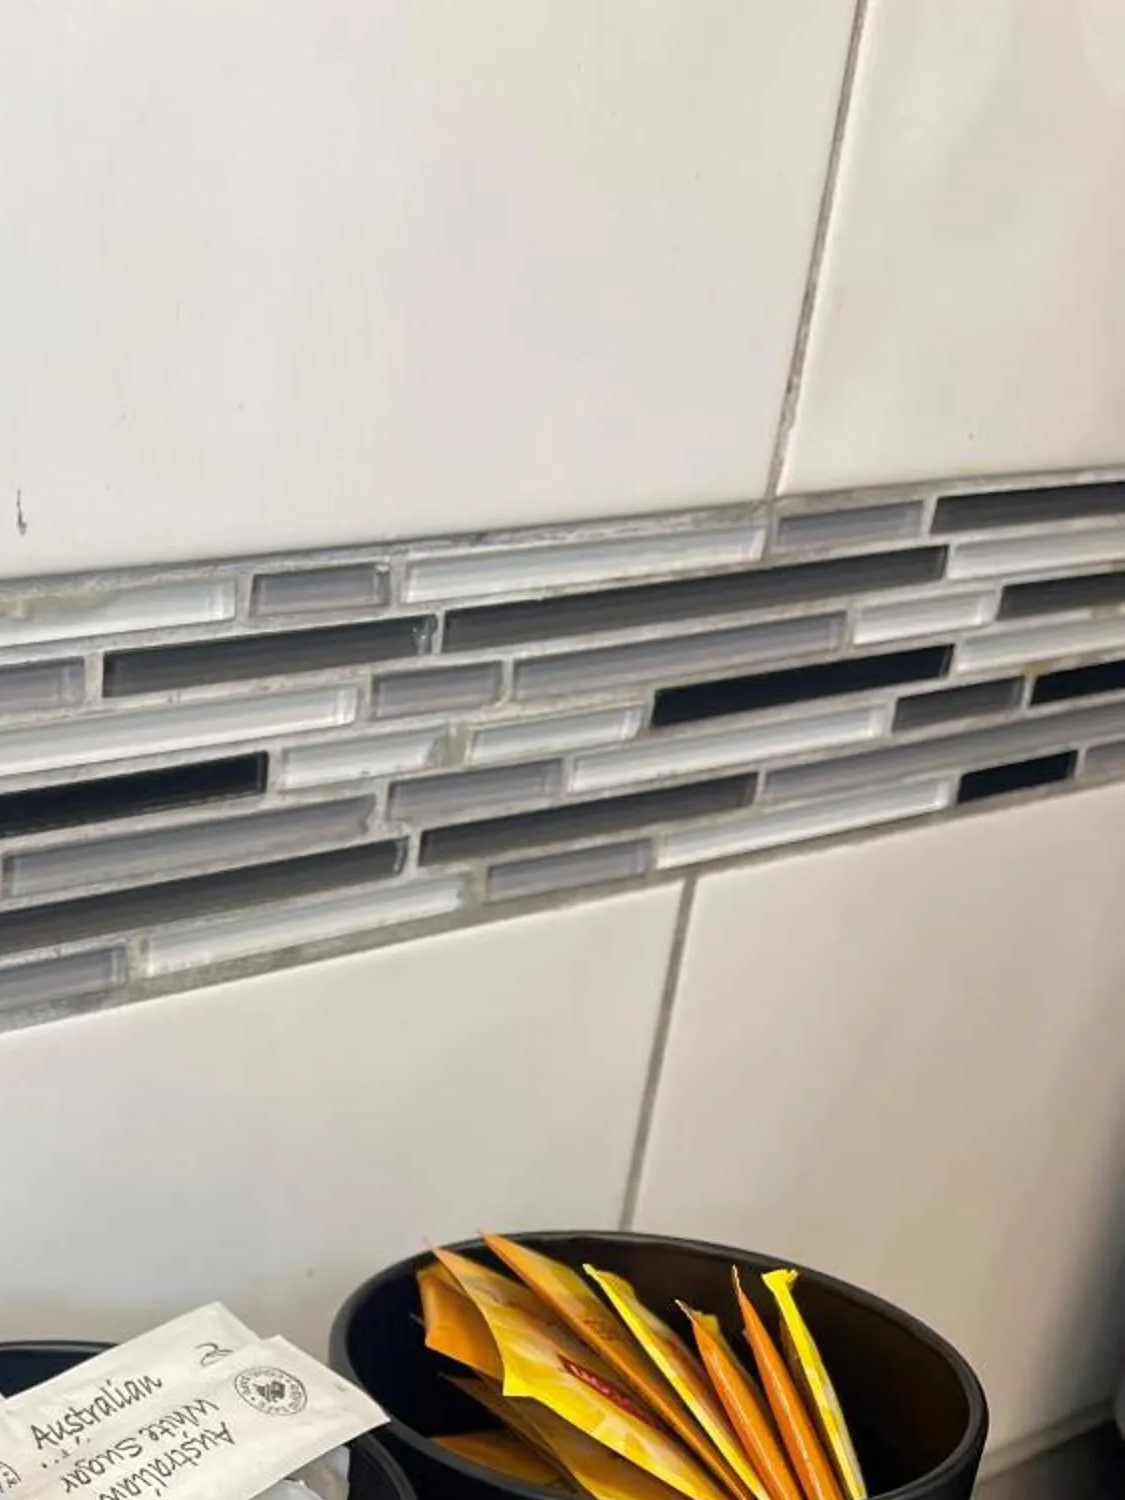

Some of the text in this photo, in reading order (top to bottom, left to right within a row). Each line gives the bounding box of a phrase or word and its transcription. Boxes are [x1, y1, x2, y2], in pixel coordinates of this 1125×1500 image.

[30, 1375, 163, 1449] Australian
[138, 1399, 220, 1441] White
[61, 1437, 143, 1493] Sugar
